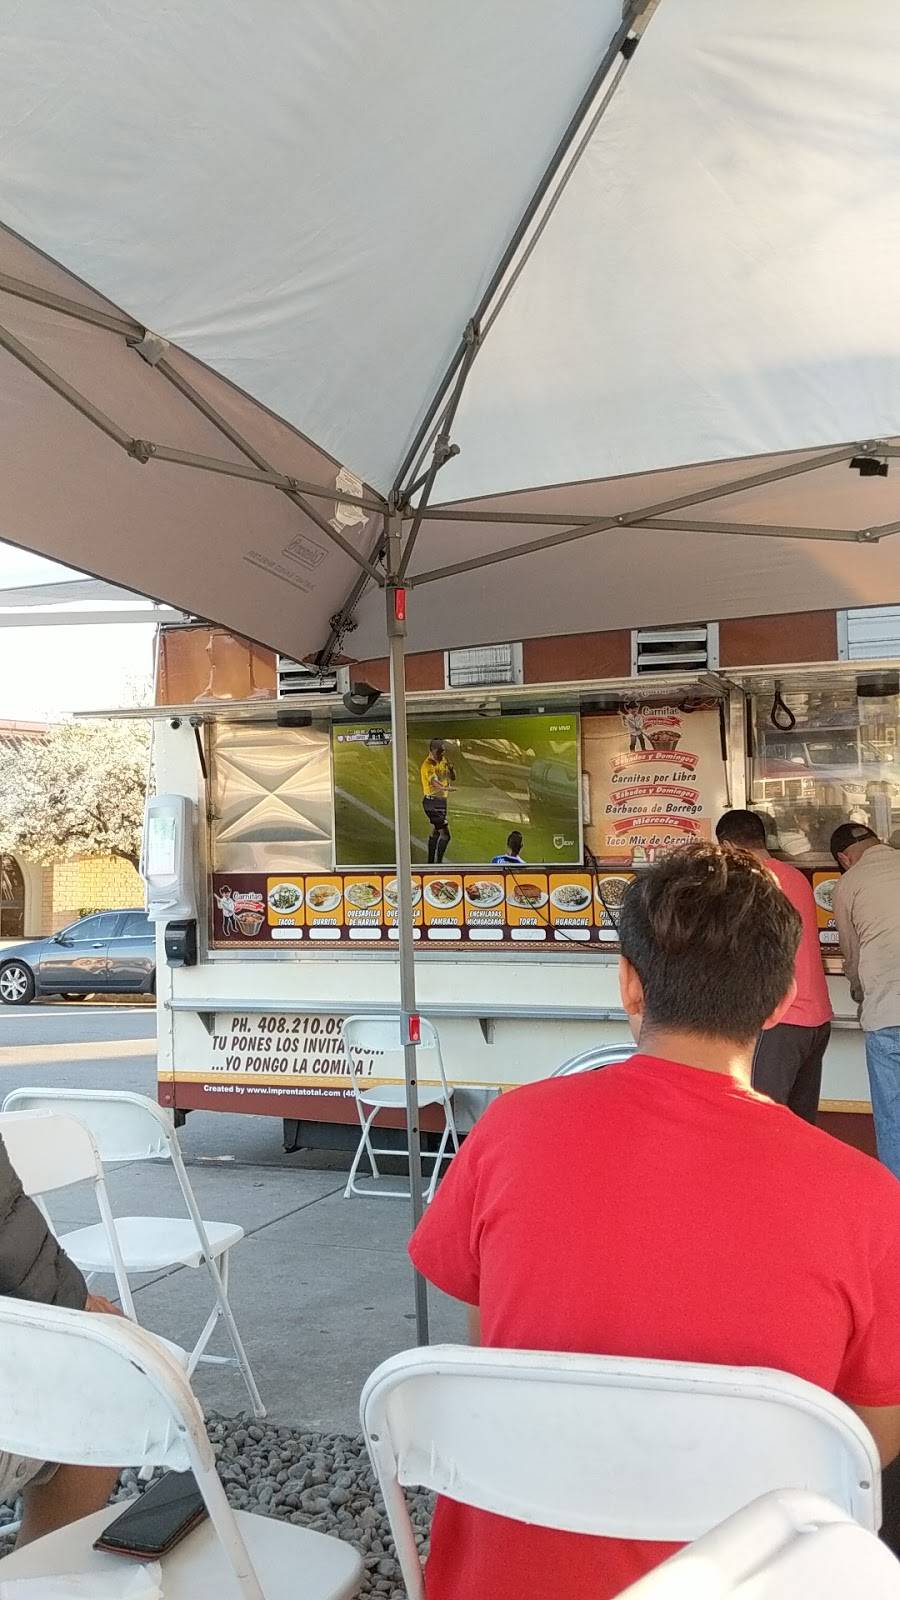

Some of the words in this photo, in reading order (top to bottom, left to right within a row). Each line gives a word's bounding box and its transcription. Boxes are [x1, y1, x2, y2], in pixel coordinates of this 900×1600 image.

[655, 752, 694, 763] Domingos
[611, 774, 651, 784] Carnitas
[653, 775, 670, 785] por
[672, 771, 697, 782] Libra
[656, 786, 695, 798] Domingos
[605, 804, 648, 814] Barbacoa
[651, 803, 662, 812] de
[665, 803, 703, 815] Borrego
[606, 836, 626, 846] Taco
[629, 836, 647, 845] Mix
[649, 835, 661, 845] de
[278, 918, 295, 926] TACOS
[312, 918, 337, 926] BURRITO
[430, 918, 458, 926] PAMBAZO
[518, 918, 538, 926] TORTA
[555, 918, 589, 927] HUARACHE
[231, 1017, 251, 1033] PH.
[212, 1036, 228, 1051] TU
[231, 1037, 272, 1052] PONES
[276, 1038, 299, 1053] LOS
[244, 1057, 288, 1073] PONGO
[292, 1058, 308, 1074] LA
[203, 1085, 234, 1093] Created
[235, 1087, 245, 1095] by
[246, 1087, 341, 1098] www.imprentatotal.com
